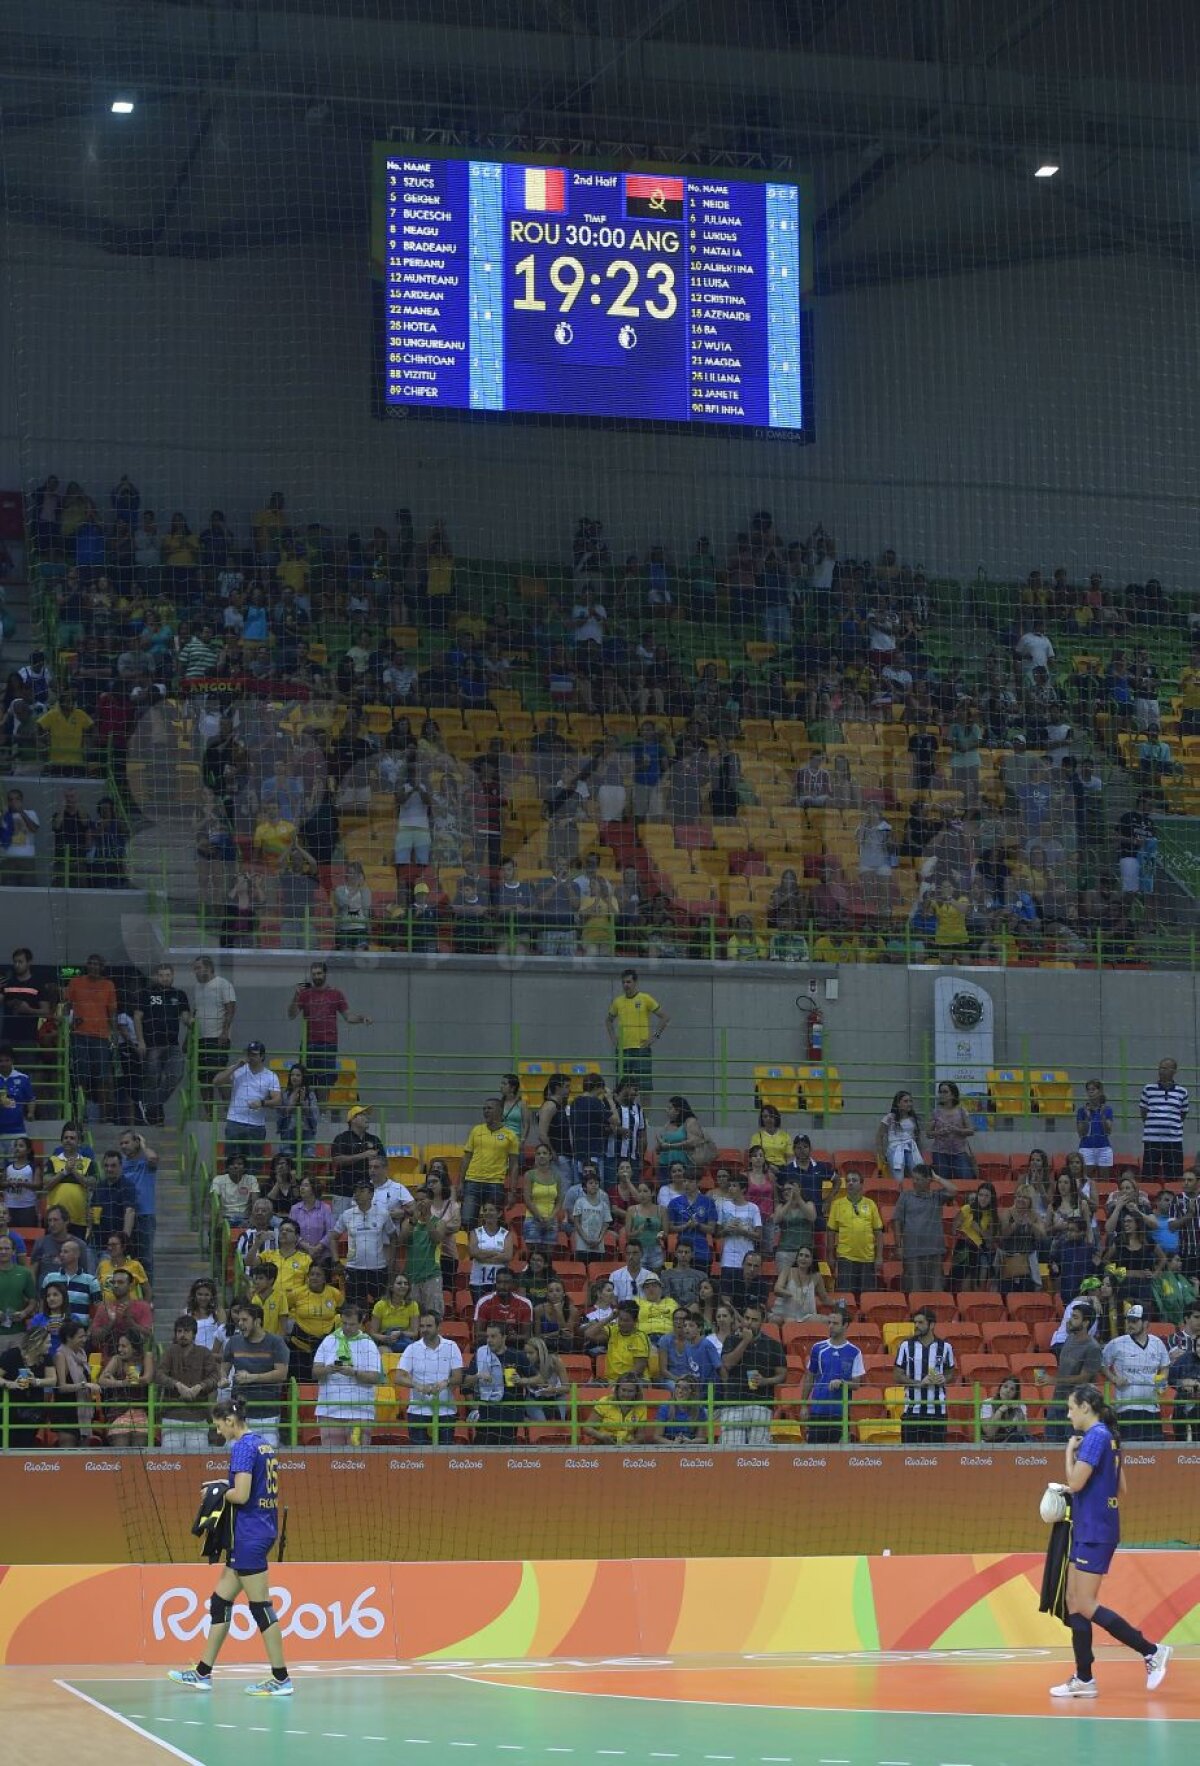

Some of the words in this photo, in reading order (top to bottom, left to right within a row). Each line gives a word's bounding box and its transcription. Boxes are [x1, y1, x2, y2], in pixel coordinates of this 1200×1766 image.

[404, 162, 431, 172] NAME
[403, 177, 435, 188] SZUCS
[573, 174, 593, 186] 2nd
[595, 176, 617, 187] Half
[703, 185, 728, 194] NAME
[403, 193, 440, 204] GEIGER
[703, 200, 730, 209] NEIDE
[390, 208, 396, 217] 7
[403, 209, 451, 221] BUCESCHI
[703, 215, 742, 226] JULIANA
[403, 225, 439, 236] NEAGU
[690, 229, 696, 238] 8
[703, 230, 737, 241] LURDES
[510, 221, 560, 245] ROU
[565, 225, 625, 248] 30:00
[629, 229, 680, 253] ANG
[390, 240, 396, 249] 9
[403, 241, 457, 253] BRADEANU
[690, 245, 696, 253] 9
[703, 246, 742, 257] NATALIA
[390, 257, 401, 266] 11
[403, 258, 445, 269] PERIANU
[690, 261, 701, 270] 10
[703, 262, 754, 274] ALBERTINA
[390, 273, 401, 282] 12
[403, 273, 458, 286] MUNTEANU
[691, 278, 701, 286] 11
[703, 278, 730, 288] LUISA
[513, 253, 678, 319] 19:23
[403, 290, 444, 300] ARDEAN
[691, 293, 702, 302] 12
[703, 294, 746, 305] CRISTINA
[390, 305, 401, 314] 22
[403, 306, 440, 316] MANEA
[704, 310, 751, 321] AZENAIDE
[403, 321, 437, 333] HOTEA
[704, 325, 717, 335] BA
[390, 337, 401, 346] 30
[403, 338, 465, 350] UNGUREANU
[691, 340, 702, 349] 17
[704, 342, 732, 351] WUTA
[403, 353, 455, 365] CHINTOAN
[704, 357, 741, 367] MAGDA
[403, 370, 436, 380] VIZITIU
[704, 372, 741, 383] LILIANA
[403, 386, 438, 397] CHIPER
[704, 389, 739, 400] JANETE
[190, 683, 242, 692] ANGOLA
[150, 995, 162, 1005] 35
[482, 1267, 496, 1283] 14
